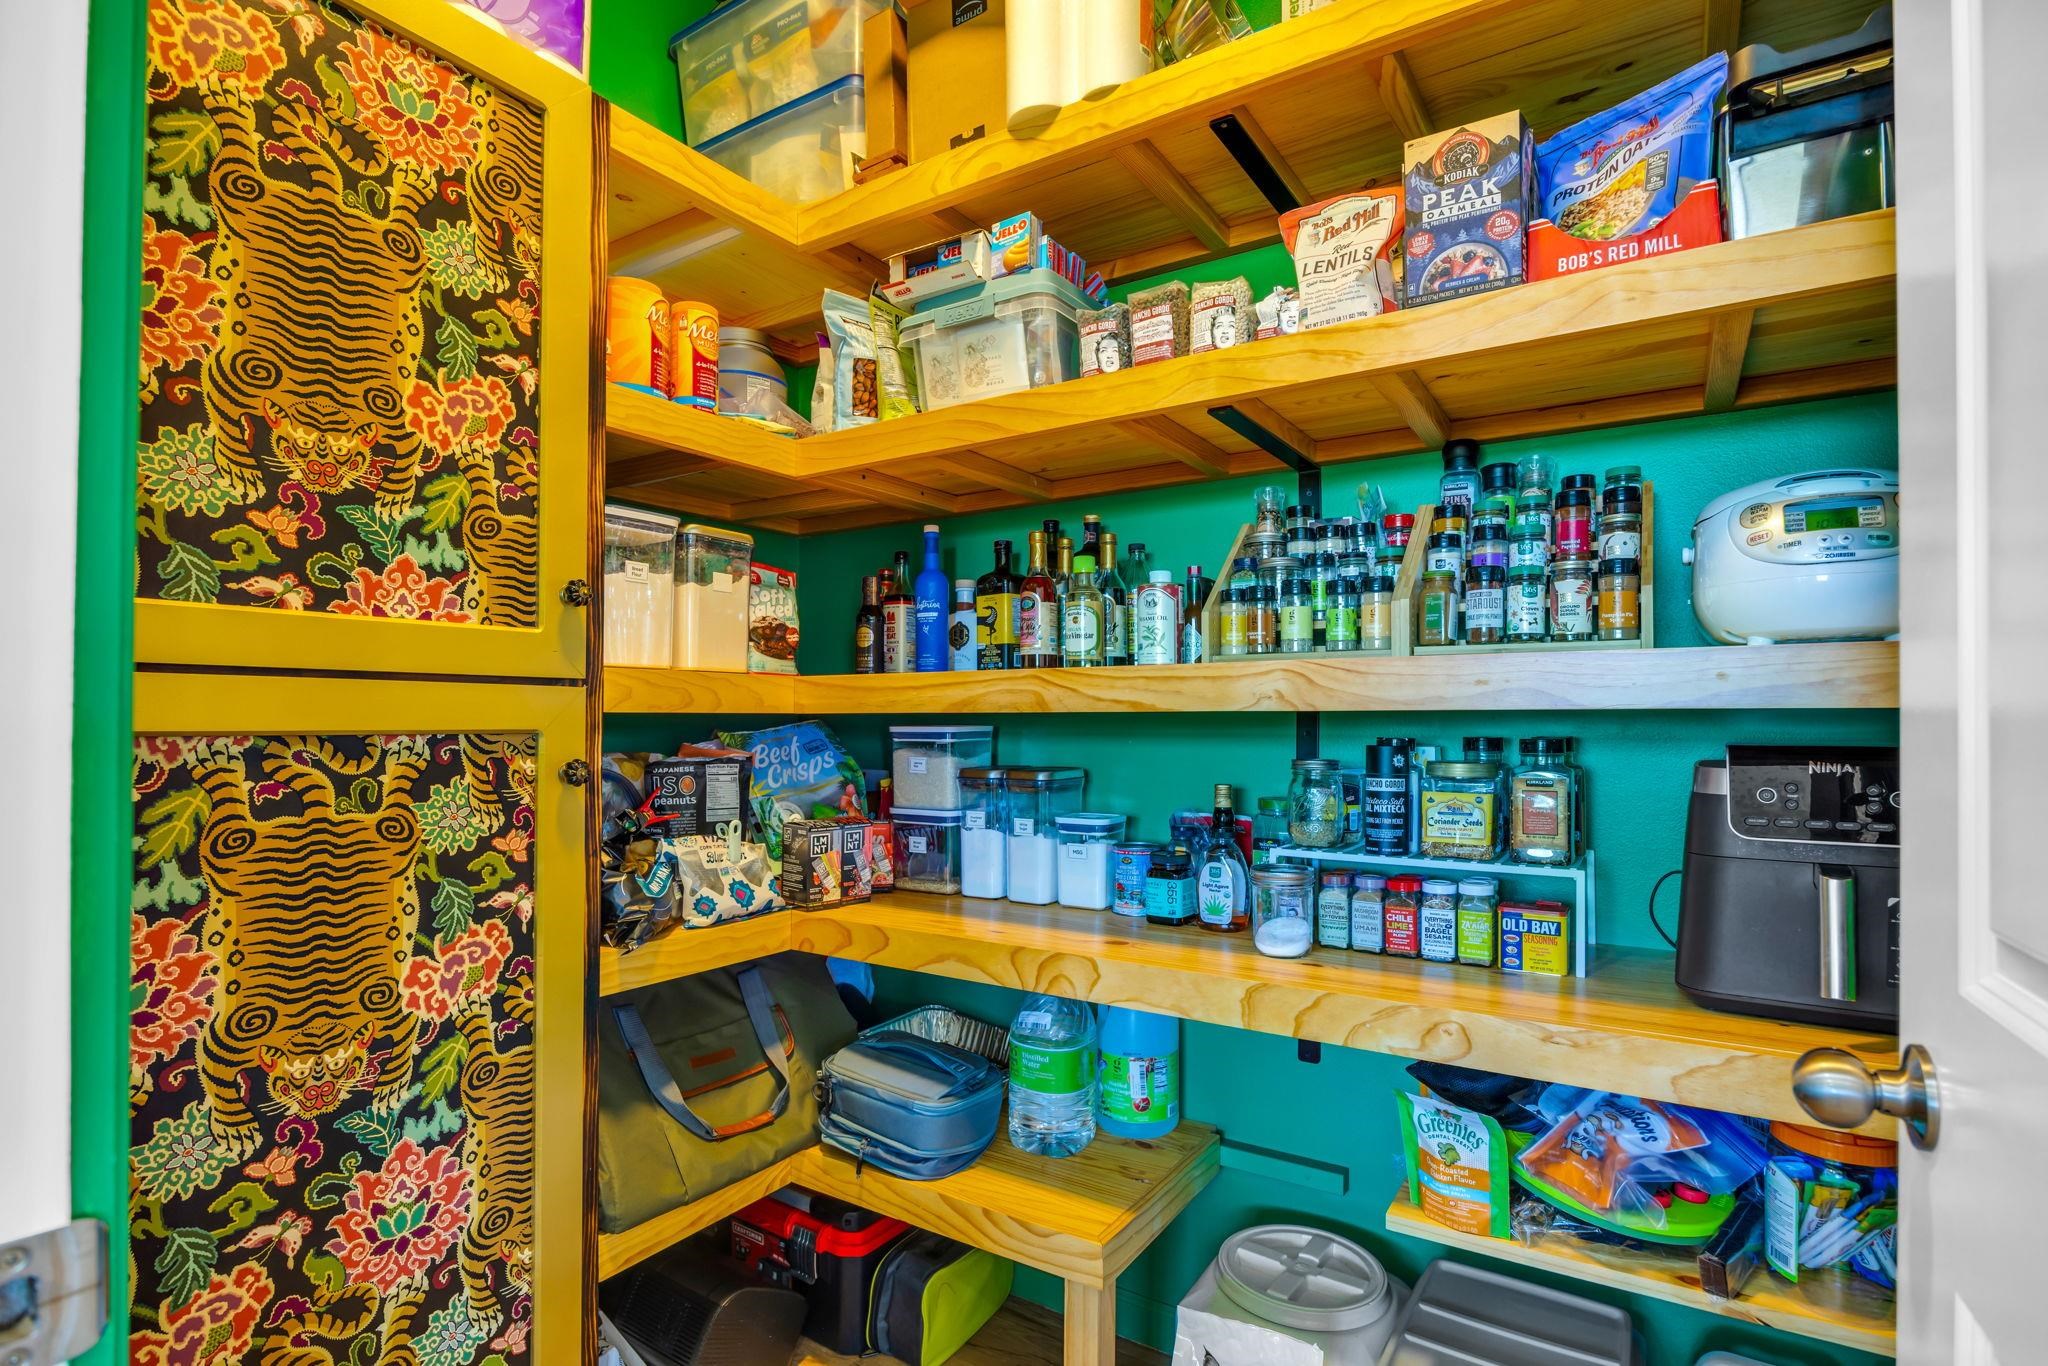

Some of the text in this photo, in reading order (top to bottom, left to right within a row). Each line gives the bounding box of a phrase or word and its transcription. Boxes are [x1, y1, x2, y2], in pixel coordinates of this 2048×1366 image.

[955, 4, 983, 25] prime
[1649, 151, 1668, 164] 50%
[1443, 165, 1480, 185] KODIAK
[1553, 161, 1619, 207] PROTEIN
[1422, 177, 1502, 211] PEAK
[1426, 196, 1497, 220] OATMEAL
[1321, 201, 1380, 245] Red Mill
[1558, 234, 1683, 272] BOB'S RED MILL
[1302, 246, 1374, 278] LENTILS
[1194, 295, 1235, 310] RANCHO GORDO
[1151, 304, 1170, 316] GORDO
[1097, 321, 1117, 331] GORDO
[1444, 494, 1468, 504] PINK
[1527, 514, 1539, 522] 365
[1750, 532, 1769, 543] RESET
[1783, 540, 1802, 549] TIMER
[750, 585, 786, 606] Soft
[1523, 586, 1537, 594] 365
[751, 736, 800, 769] Beef
[652, 765, 695, 774] JAPANESE
[767, 751, 835, 788] Crisps
[1808, 760, 1855, 777] NINJA
[1385, 779, 1405, 788] GORDO
[654, 795, 697, 808] peanuts
[1389, 797, 1405, 805] Salt
[1373, 804, 1405, 813] MIXTECA
[1427, 816, 1484, 827] Coriander Seeds
[814, 837, 827, 845] LM
[848, 832, 859, 841] LM
[848, 841, 859, 850] NT
[814, 846, 827, 857] NT
[706, 851, 724, 864] Blue
[1386, 913, 1413, 922] CHILE
[1424, 915, 1453, 924] EVERYTHING
[1354, 924, 1379, 932] UMAMI
[1386, 921, 1409, 931] LIME
[1424, 927, 1452, 936] BAGEL
[1502, 917, 1558, 935] OLD BAY
[1424, 933, 1453, 941] SESAME
[1523, 934, 1558, 946] SEASONING
[1022, 1052, 1049, 1063] Distilled
[1022, 1059, 1041, 1069] Water
[1417, 1113, 1484, 1150] Greenies
[1452, 1137, 1474, 1153] TREATS
[1453, 1175, 1477, 1186] Flavor
[733, 1224, 762, 1242] CRAFTSMAN
